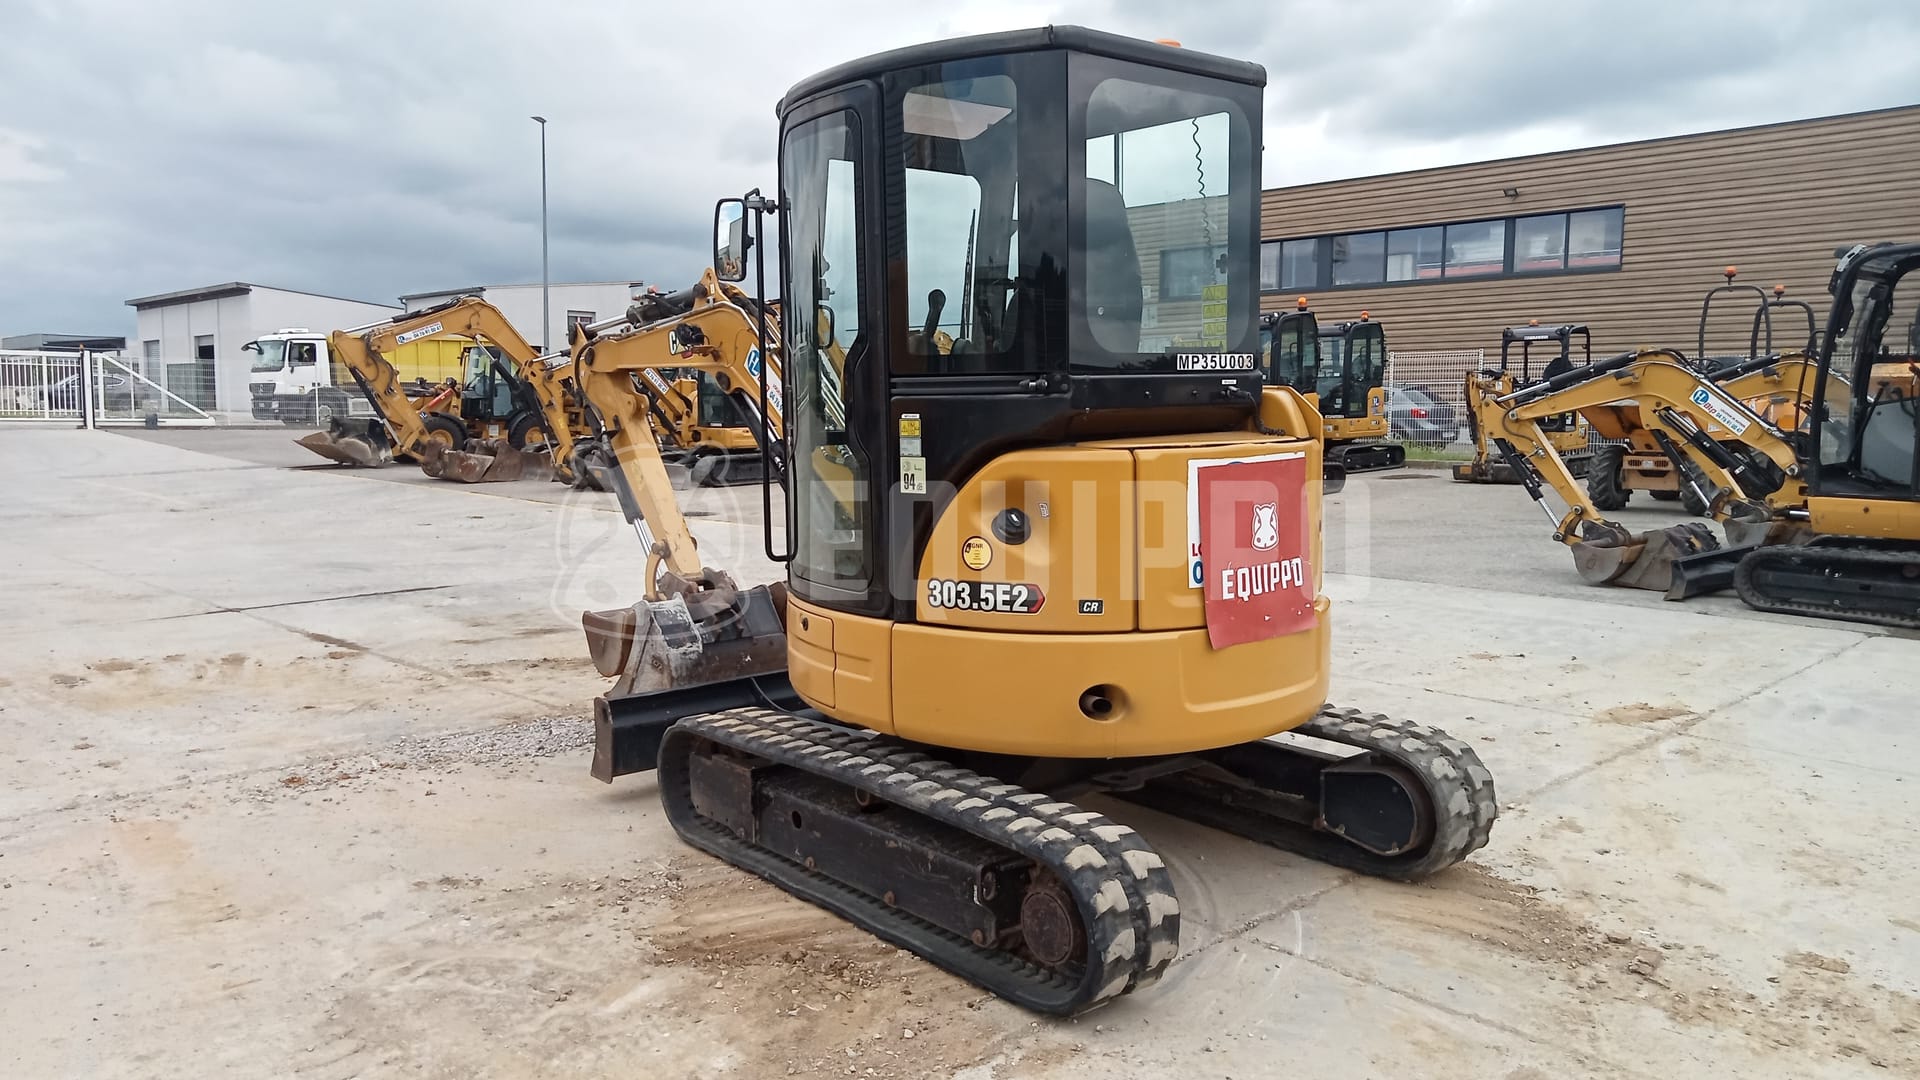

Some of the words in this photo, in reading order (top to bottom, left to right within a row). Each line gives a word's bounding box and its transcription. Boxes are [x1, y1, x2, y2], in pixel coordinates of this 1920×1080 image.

[1179, 355, 1253, 369] MP35U003
[904, 473, 915, 490] 94
[928, 579, 1029, 612] 303.5E2
[1083, 601, 1099, 612] CR
